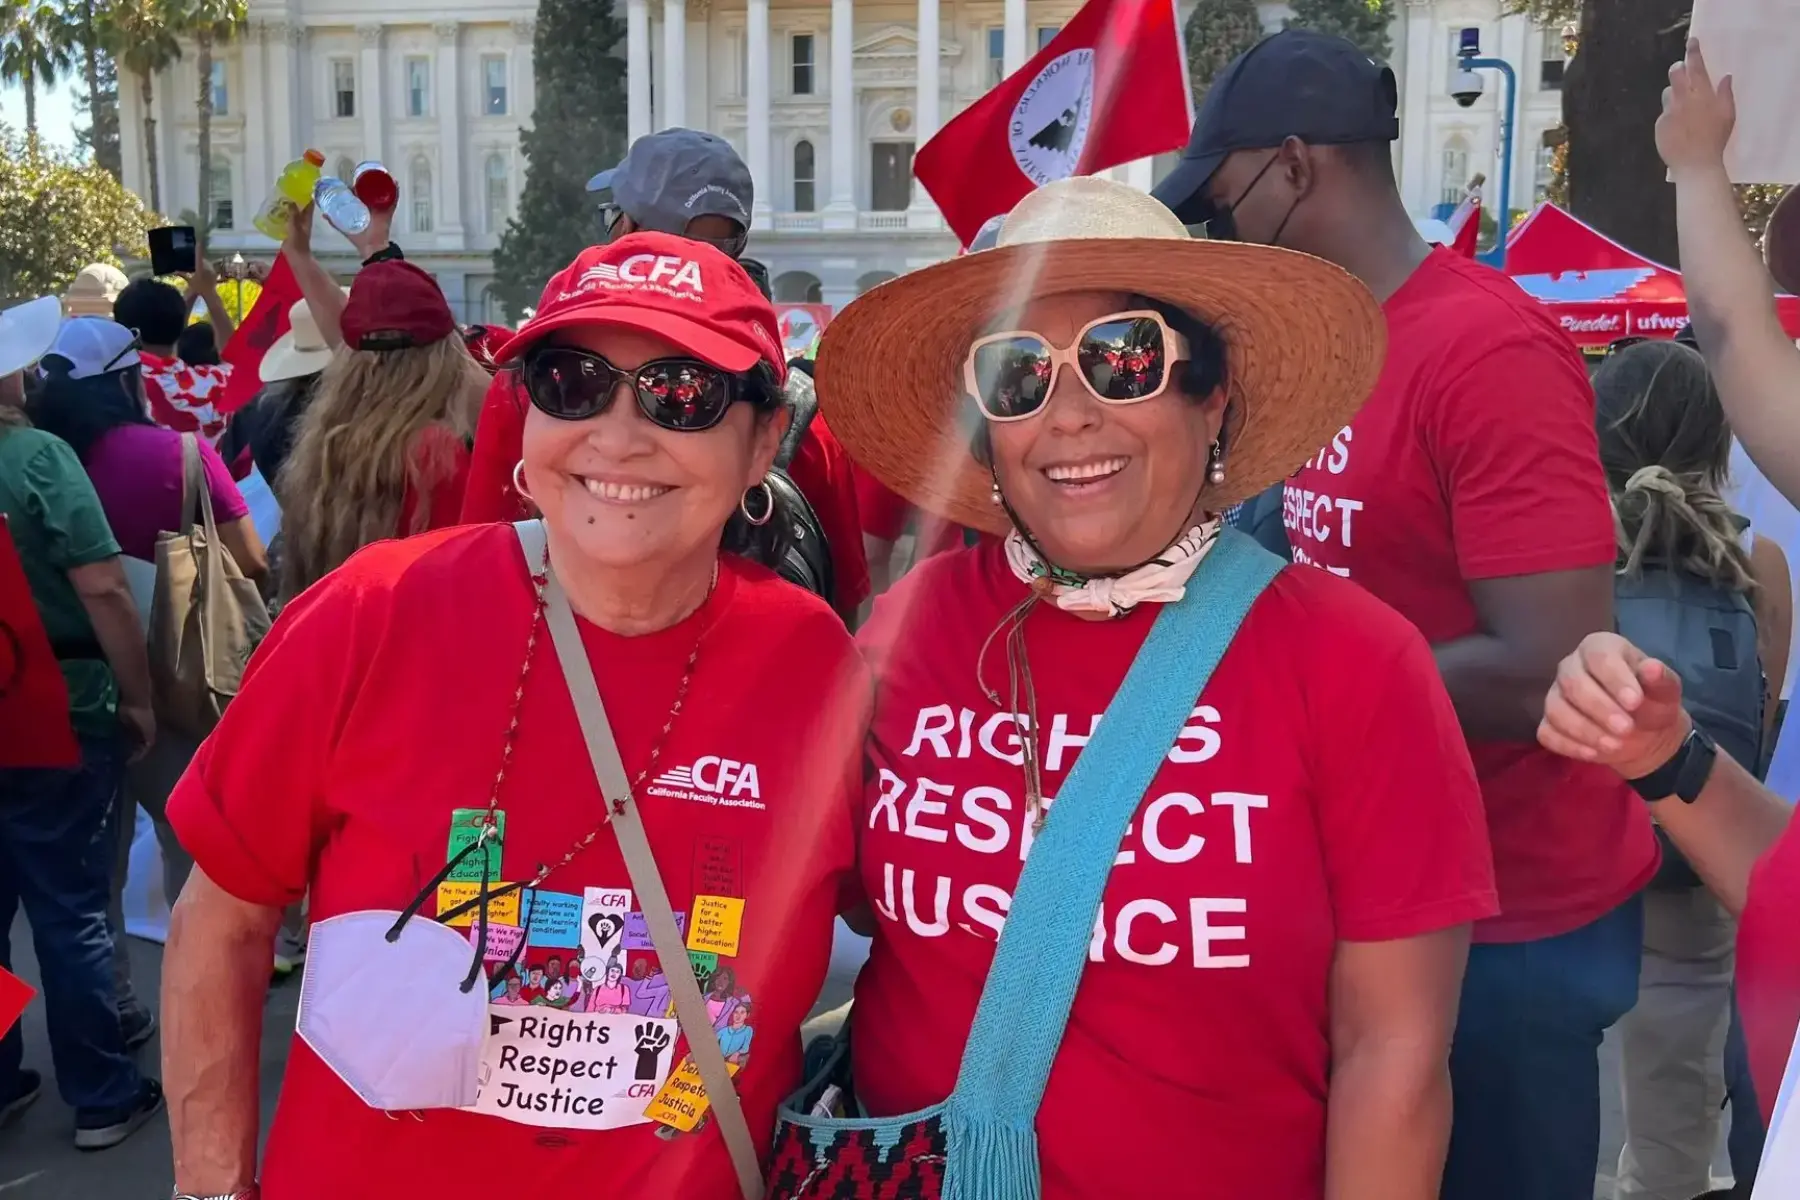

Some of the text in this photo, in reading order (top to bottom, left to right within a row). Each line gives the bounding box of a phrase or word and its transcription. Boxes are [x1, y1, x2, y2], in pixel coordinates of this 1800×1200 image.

[618, 253, 704, 293] CFA
[1282, 485, 1364, 548] ESPECT
[901, 703, 1222, 772] RIGHS
[691, 755, 761, 798] CFA
[646, 786, 766, 811] California Faculty Association
[449, 869, 499, 878] Educaton
[601, 894, 626, 908] CFA
[700, 899, 727, 910] Justice
[700, 907, 712, 917] for
[875, 862, 1252, 969] JUSICE
[496, 927, 507, 935] We
[699, 917, 724, 928] better
[628, 930, 648, 939] Social
[697, 926, 722, 938] higher
[695, 937, 735, 949] education!
[518, 1016, 611, 1048] Rights
[499, 1045, 618, 1084] Respect
[627, 1083, 656, 1099] CFA
[670, 1077, 707, 1098] Respeto
[496, 1082, 604, 1116] Justice
[658, 1092, 697, 1119] Justicia
[661, 1111, 678, 1123] CFA
